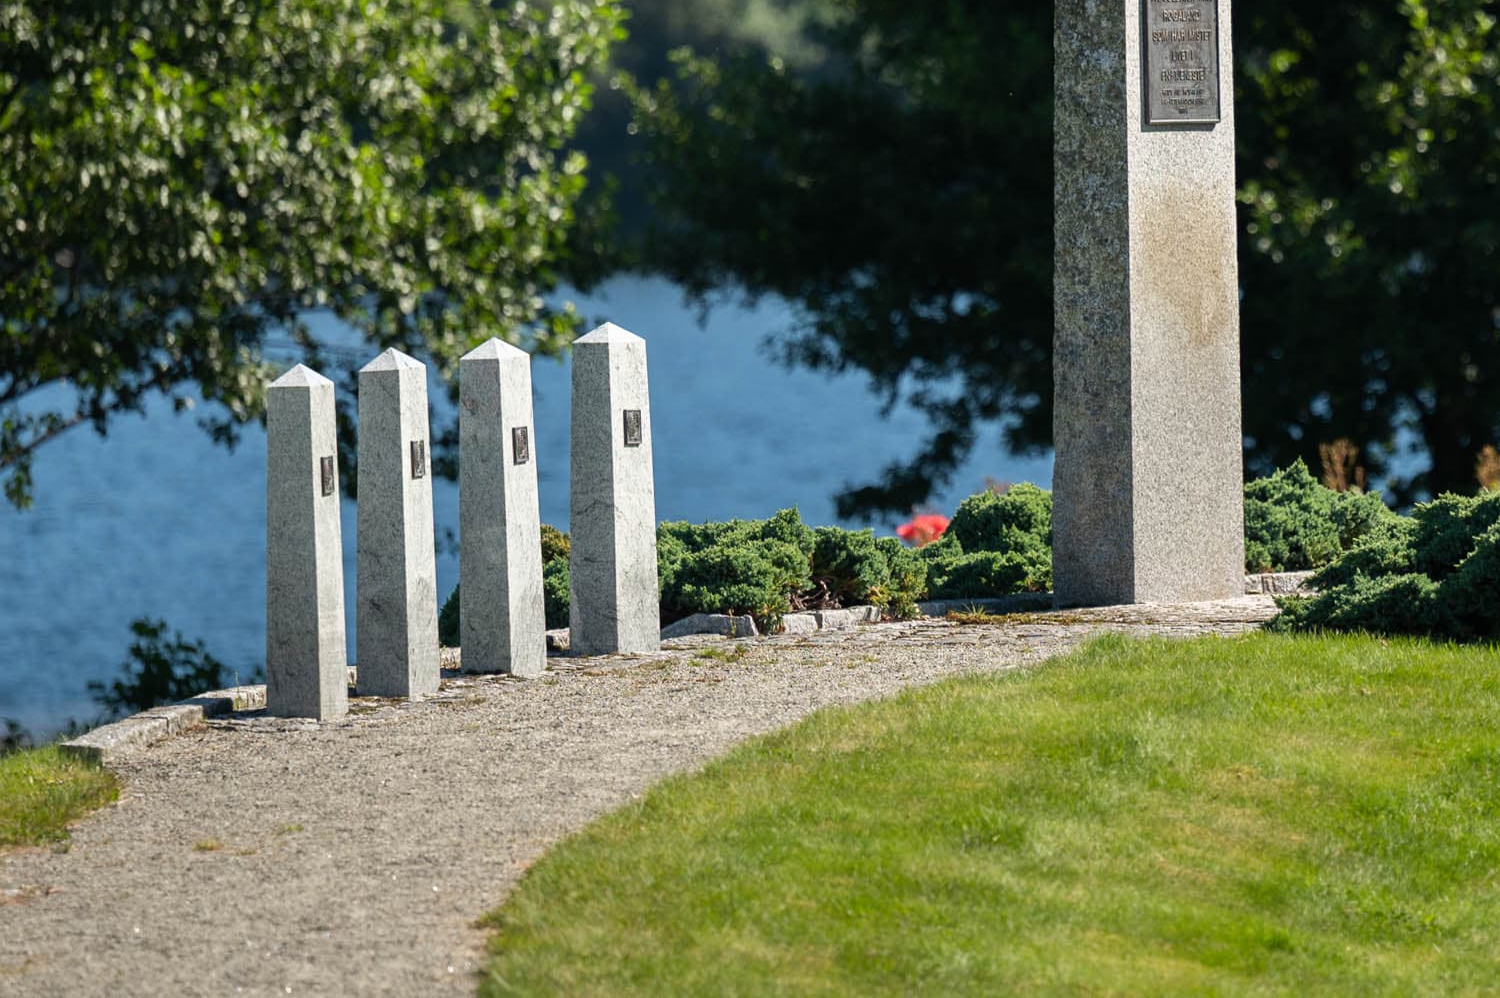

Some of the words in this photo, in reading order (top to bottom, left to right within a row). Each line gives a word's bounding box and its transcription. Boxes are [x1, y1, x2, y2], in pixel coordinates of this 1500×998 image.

[1162, 9, 1200, 23] ROGALAND
[1152, 29, 1168, 43] SOM
[1170, 29, 1185, 43] HAR
[1187, 29, 1211, 43] MISTET
